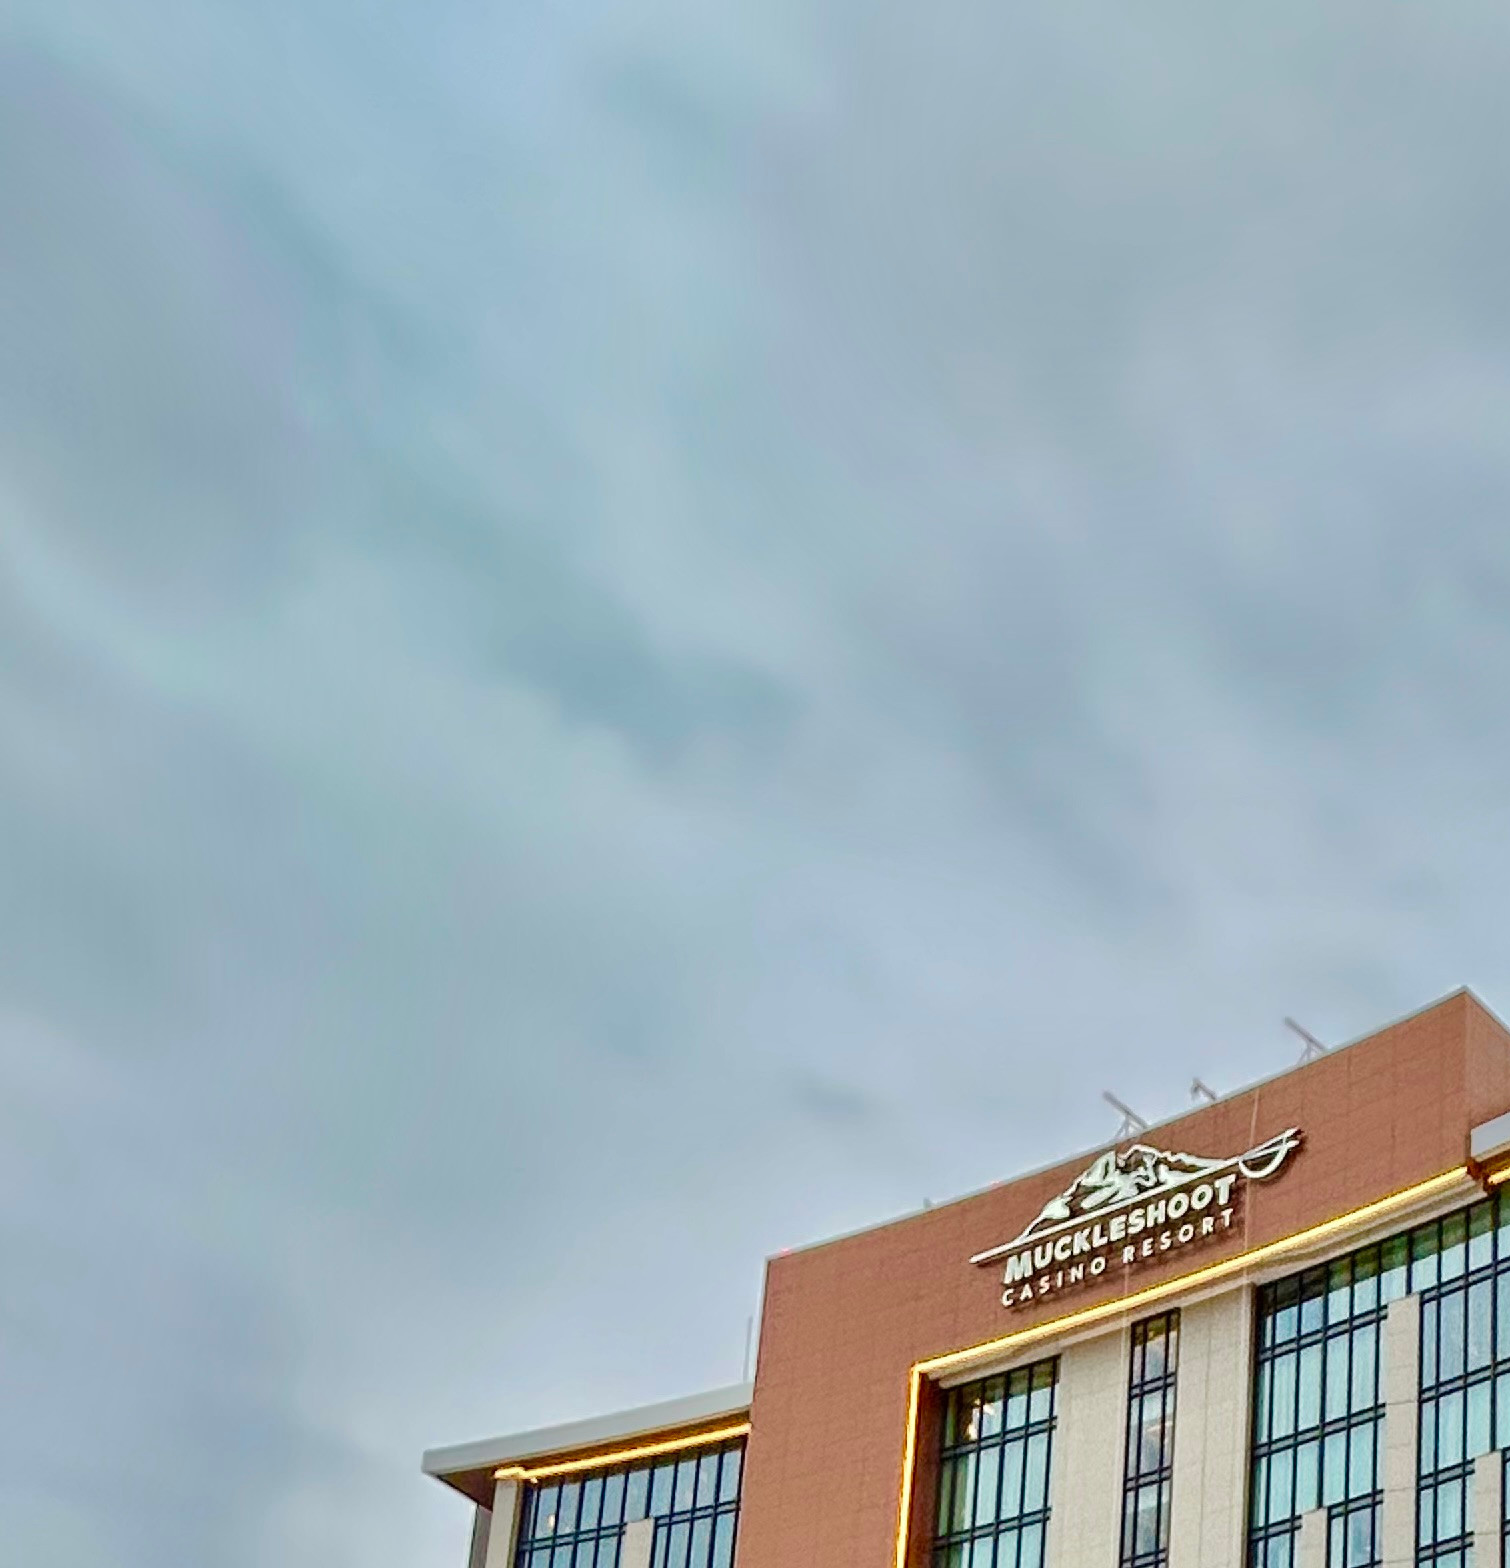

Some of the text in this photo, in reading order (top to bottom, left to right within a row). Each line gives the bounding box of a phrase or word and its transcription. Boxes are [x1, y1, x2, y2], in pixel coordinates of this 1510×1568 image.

[1001, 1208, 1234, 1307] CASINO RESORT
[1003, 1174, 1236, 1284] MUCKLESHOOT
